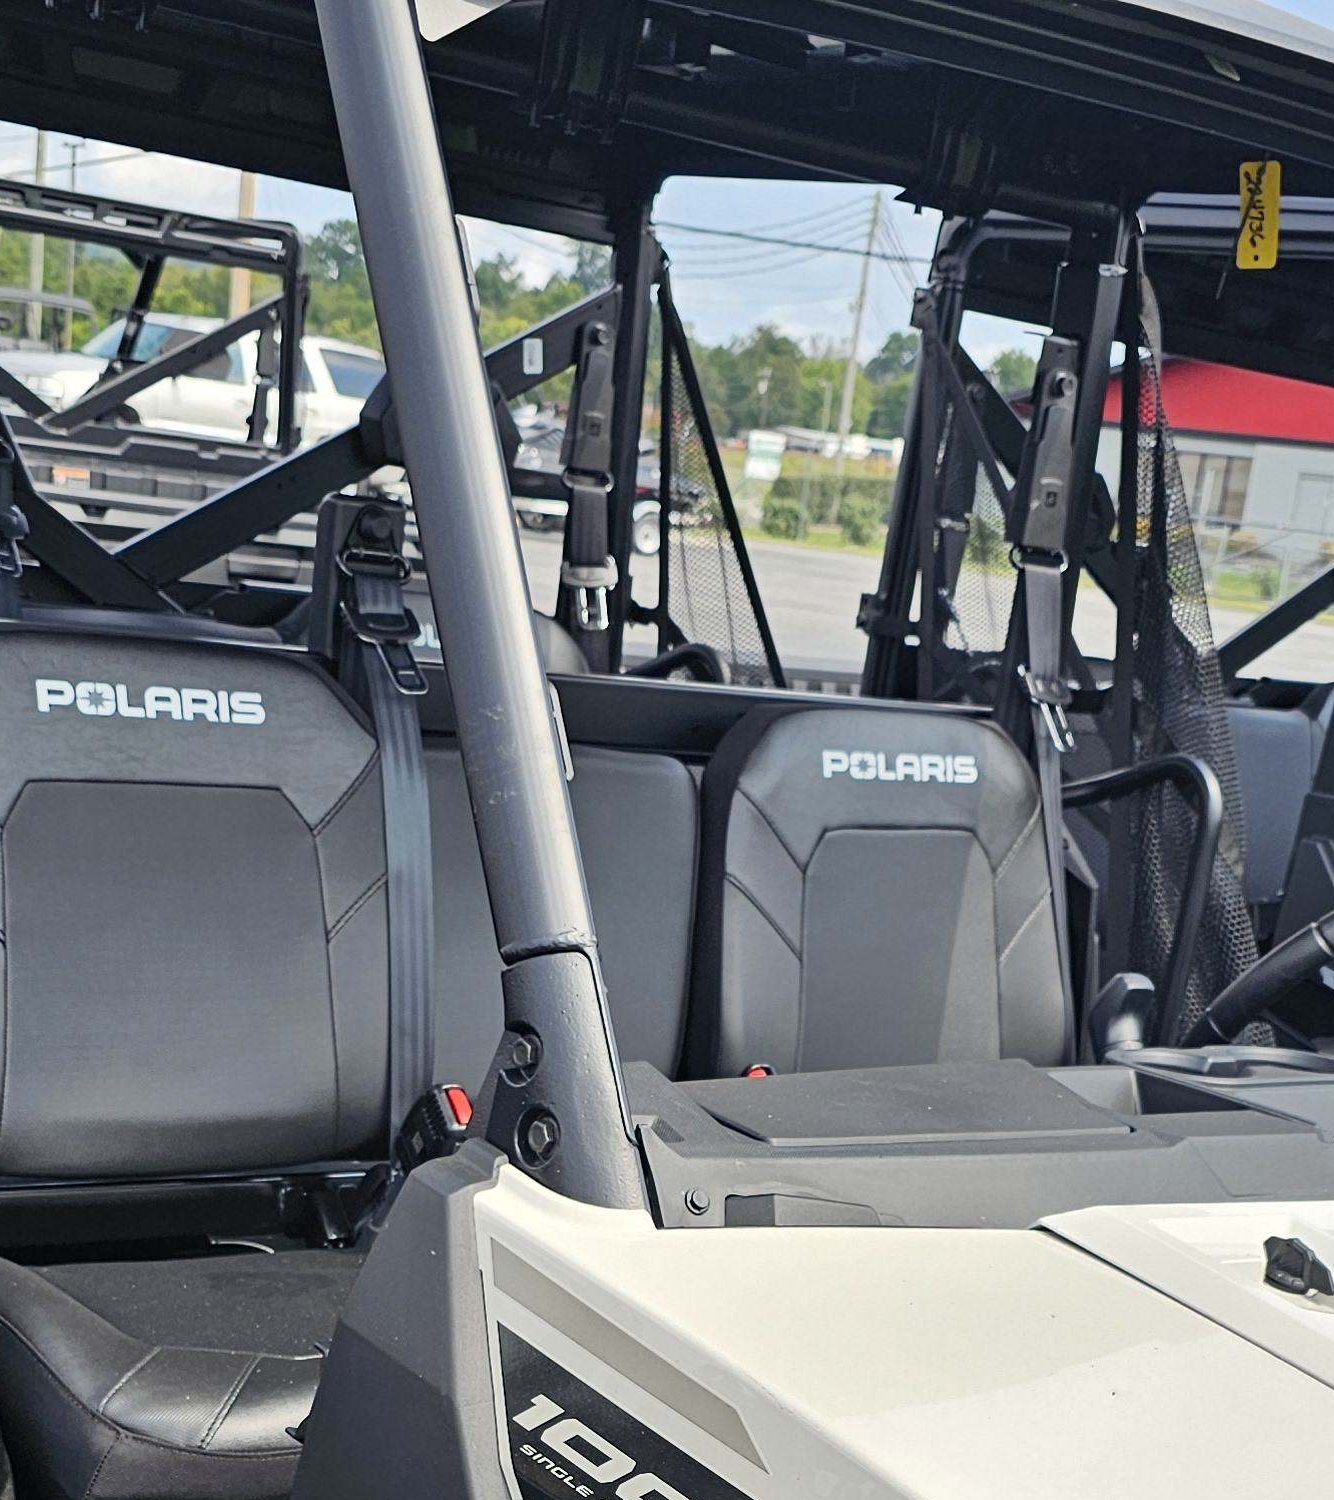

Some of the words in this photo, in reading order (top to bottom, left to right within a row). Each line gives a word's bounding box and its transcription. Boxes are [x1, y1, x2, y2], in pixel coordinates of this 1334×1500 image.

[35, 678, 266, 725] POLARIS
[822, 750, 979, 784] POLARIS
[520, 1444, 594, 1498] SINGLE
